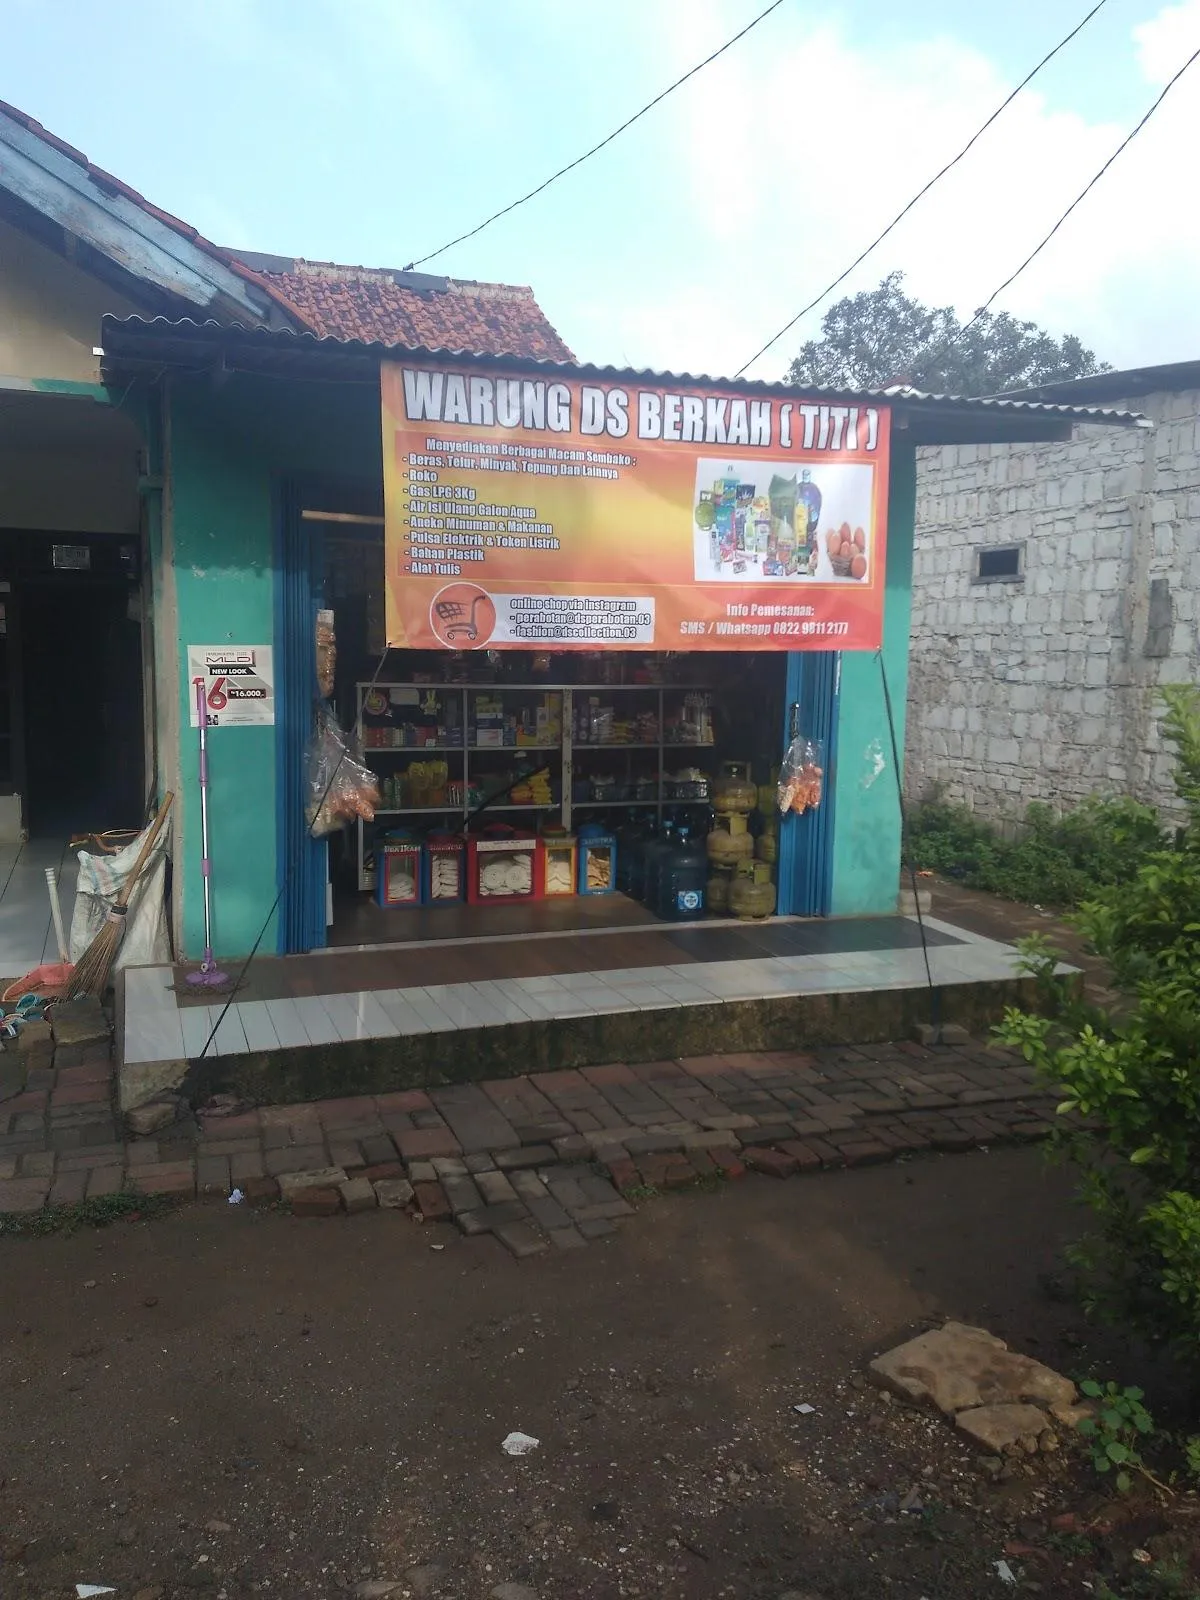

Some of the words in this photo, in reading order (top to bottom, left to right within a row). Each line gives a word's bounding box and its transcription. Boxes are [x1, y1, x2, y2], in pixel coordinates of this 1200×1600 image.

[403, 368, 572, 433] WARUNG
[580, 385, 629, 438] DS
[638, 391, 771, 447] BERKAH
[799, 404, 859, 450] TITI
[426, 438, 499, 454] Menyediakan
[501, 444, 546, 459] Berbagai
[548, 448, 585, 461] Macam
[586, 451, 631, 465] Sembako
[409, 453, 445, 467] Beras,
[447, 455, 478, 470] Telur,
[480, 457, 520, 473] Minyak,
[521, 461, 558, 476] Tepung
[560, 464, 580, 476] Dan
[582, 465, 618, 480] Lainnya
[409, 469, 438, 482] Roko
[409, 484, 431, 497] Gas
[432, 485, 453, 499] LPG
[454, 486, 476, 501] 3Kg
[409, 500, 426, 513] Air
[427, 501, 442, 513] Isi
[444, 502, 476, 517] Ulang
[478, 503, 508, 517] Galon
[510, 505, 536, 519] Aqua
[410, 515, 444, 529] Aneka
[445, 517, 496, 531] Minuman
[498, 521, 506, 532] &
[507, 520, 553, 534] Makanan
[410, 530, 441, 544] Pulsa
[442, 532, 484, 546] Elektrik
[486, 536, 494, 547] &
[495, 535, 527, 548] Token
[529, 536, 560, 550] Listrik
[411, 546, 445, 559] Bahan
[446, 548, 485, 561] Plastik
[411, 561, 432, 574] Alat
[434, 562, 461, 575] Tulis
[510, 597, 543, 609] online
[544, 598, 568, 611] shop
[569, 599, 583, 610] via
[726, 603, 748, 616] Info
[751, 604, 815, 617] Pemesanan:
[516, 612, 651, 625] perabotan@dsperabotan.03
[516, 625, 637, 638] fashion@dscollection.03
[680, 621, 705, 635] SMS
[707, 622, 715, 634] /
[716, 622, 770, 636] Whatsapp
[773, 622, 799, 635] 0822
